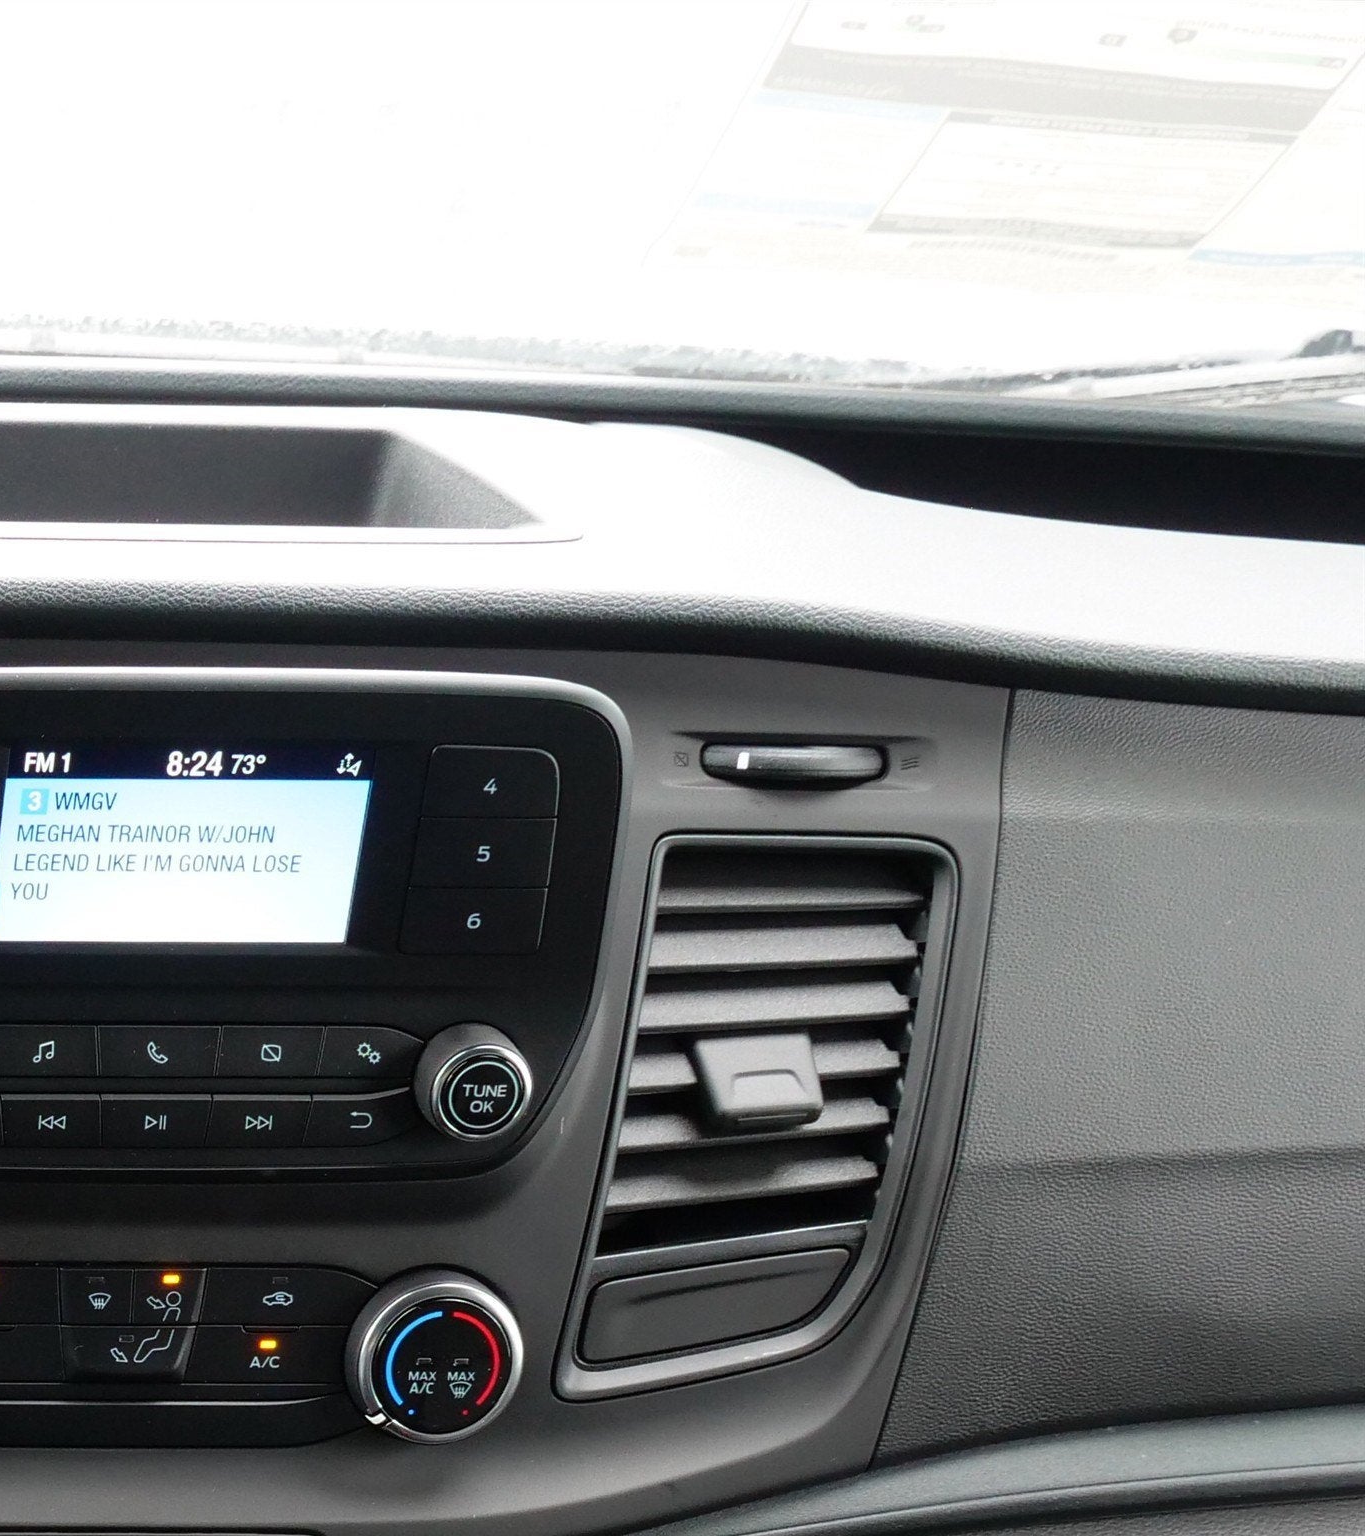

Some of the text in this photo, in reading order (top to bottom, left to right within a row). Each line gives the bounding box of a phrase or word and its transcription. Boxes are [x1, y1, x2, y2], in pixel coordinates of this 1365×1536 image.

[24, 752, 70, 773] FM 1
[167, 751, 266, 776] 8:24 73°
[484, 779, 497, 794] 4
[27, 792, 117, 812] 3 WMGV
[17, 825, 275, 843] MEGHAN TRAINOR W/JOHN
[477, 846, 490, 862] 5
[14, 854, 301, 872] LEGEND LIKE I'M GONNA LOSE
[12, 883, 48, 900] YOU
[467, 913, 481, 929] 6
[463, 1084, 507, 1097] TUNE
[470, 1101, 494, 1112] OK
[250, 1355, 281, 1368] A/C
[409, 1371, 437, 1382] MAX
[448, 1371, 475, 1382] MAX
[409, 1382, 434, 1394] A/C
